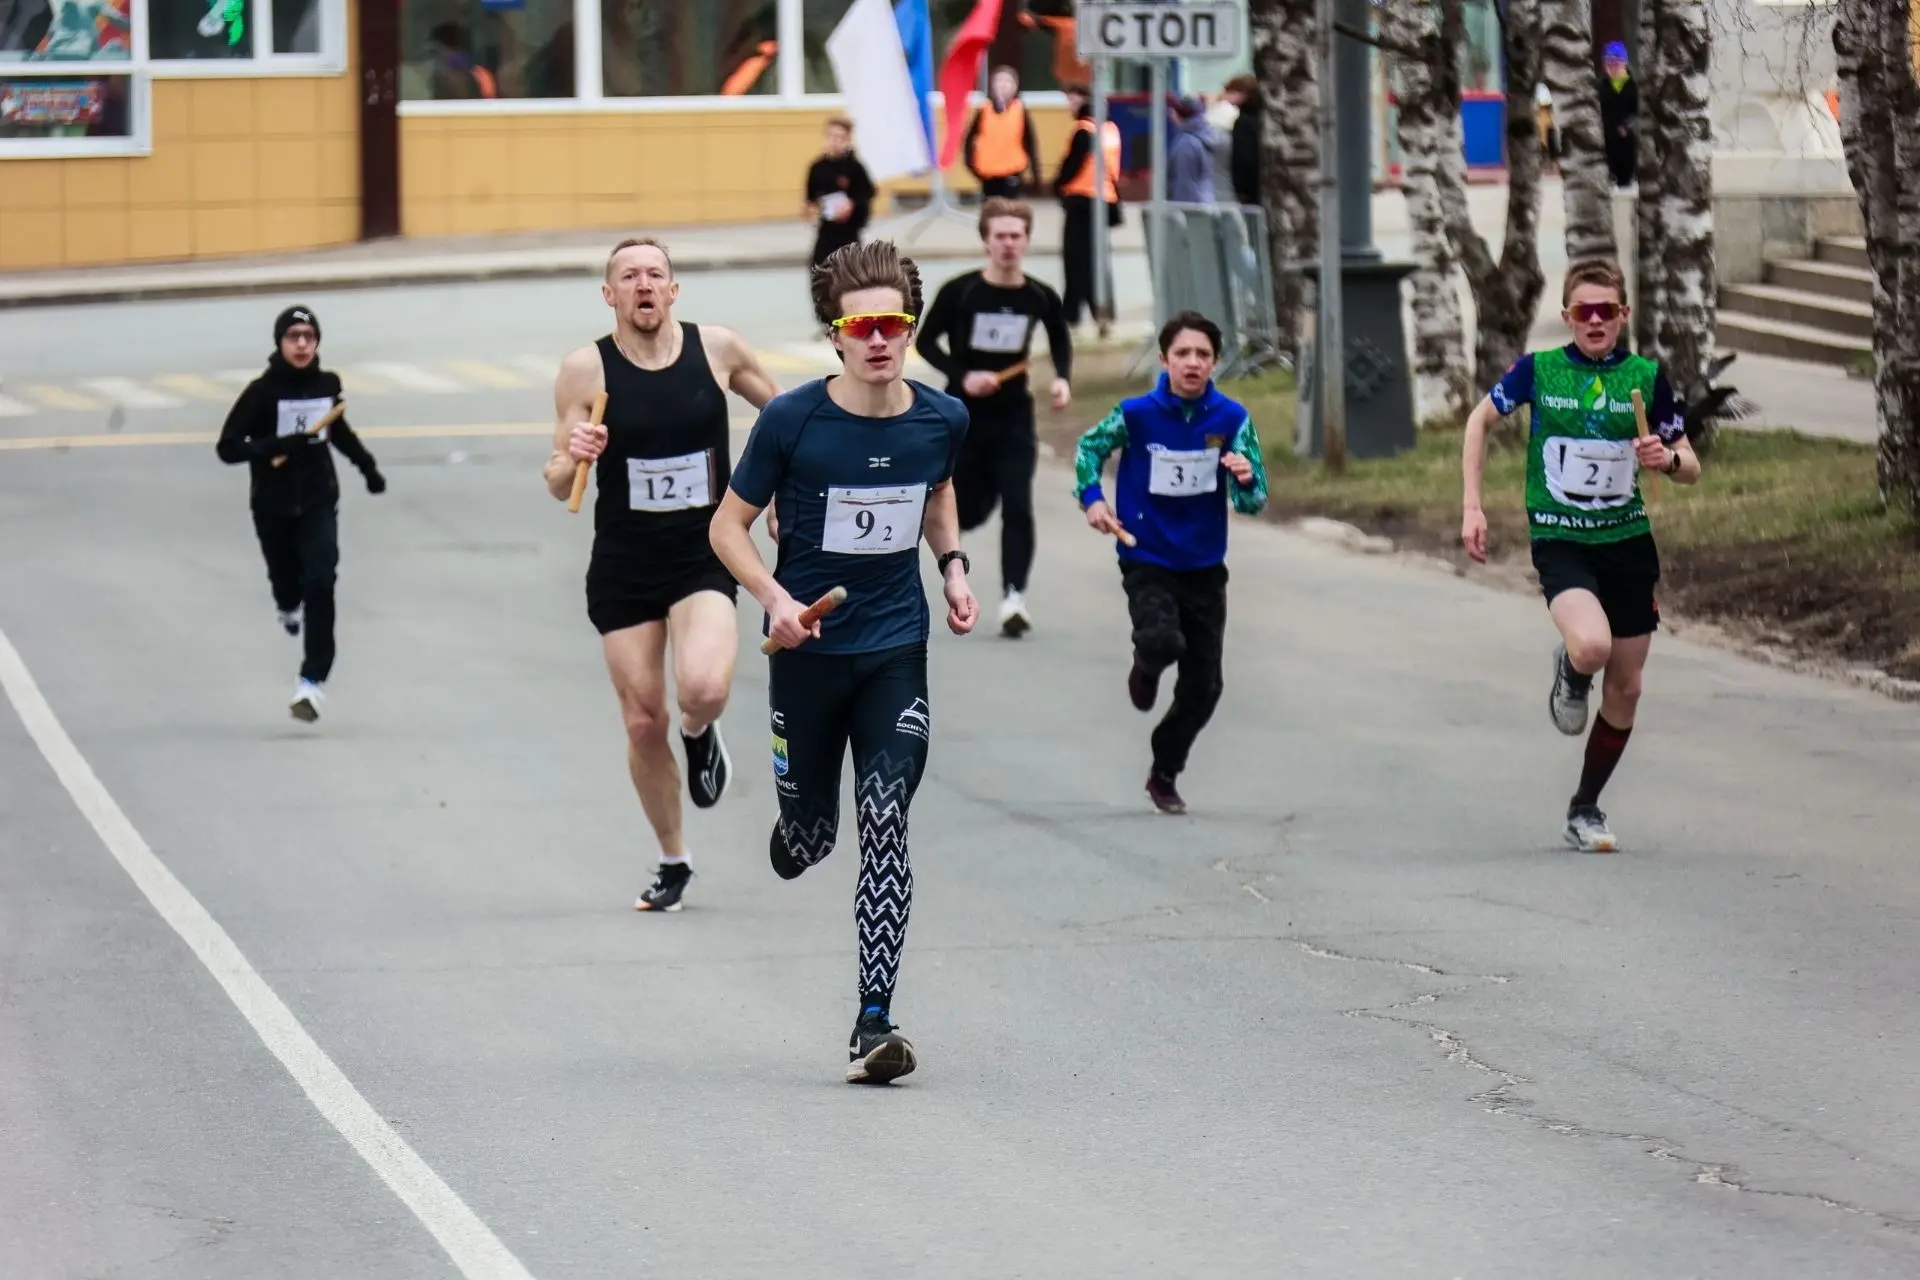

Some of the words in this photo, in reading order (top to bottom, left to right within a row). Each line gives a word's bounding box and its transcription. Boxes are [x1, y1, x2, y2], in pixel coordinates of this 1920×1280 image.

[1099, 12, 1216, 48] СТОП
[1170, 465, 1184, 487] 3
[1584, 462, 1600, 485] 2
[644, 475, 677, 500] 12
[853, 510, 875, 540] 9
[883, 525, 893, 542] 2
